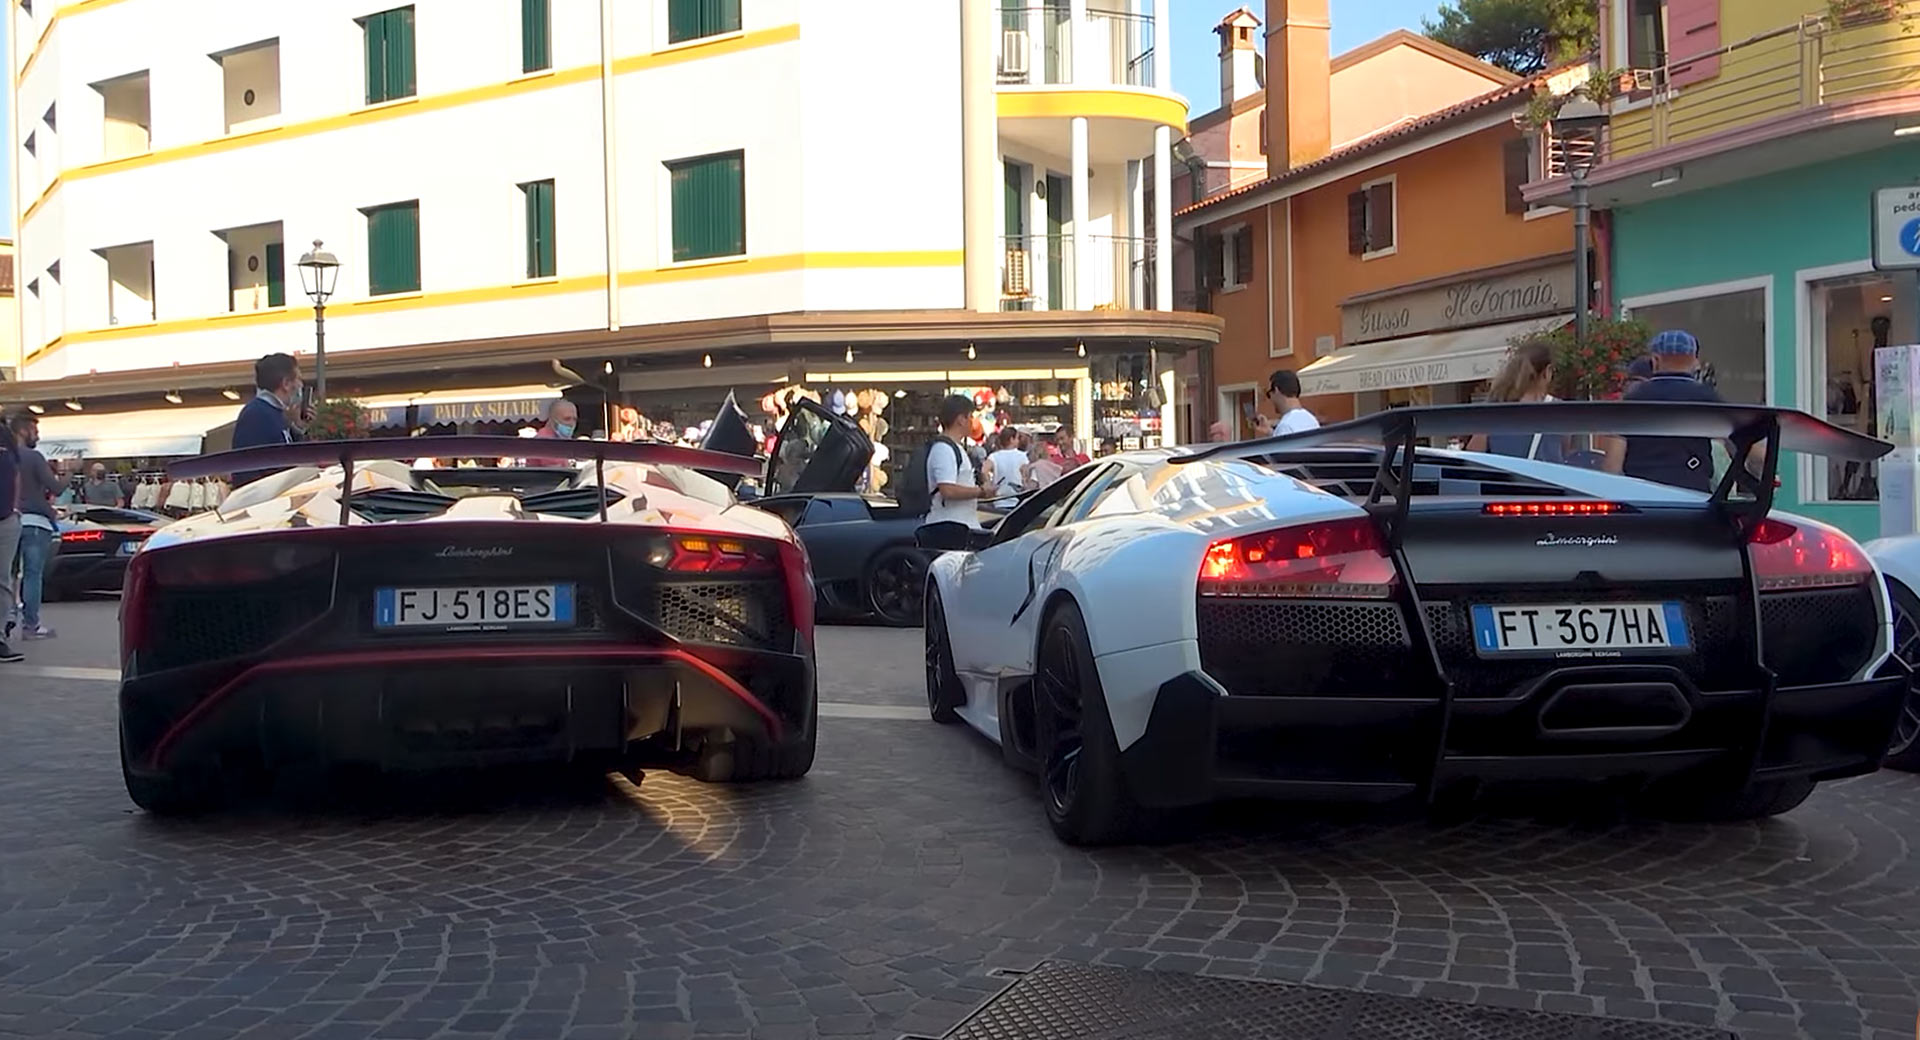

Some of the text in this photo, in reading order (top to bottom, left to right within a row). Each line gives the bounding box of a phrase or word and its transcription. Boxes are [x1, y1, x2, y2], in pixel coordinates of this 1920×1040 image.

[1360, 303, 1410, 335] Gusso
[1359, 370, 1383, 389] BREAD
[1384, 368, 1410, 387] CAKES
[1410, 366, 1425, 385] AND
[1427, 362, 1449, 383] PIZZA
[434, 400, 541, 420] PAUL & SHARK
[435, 545, 514, 559] Lamborghini
